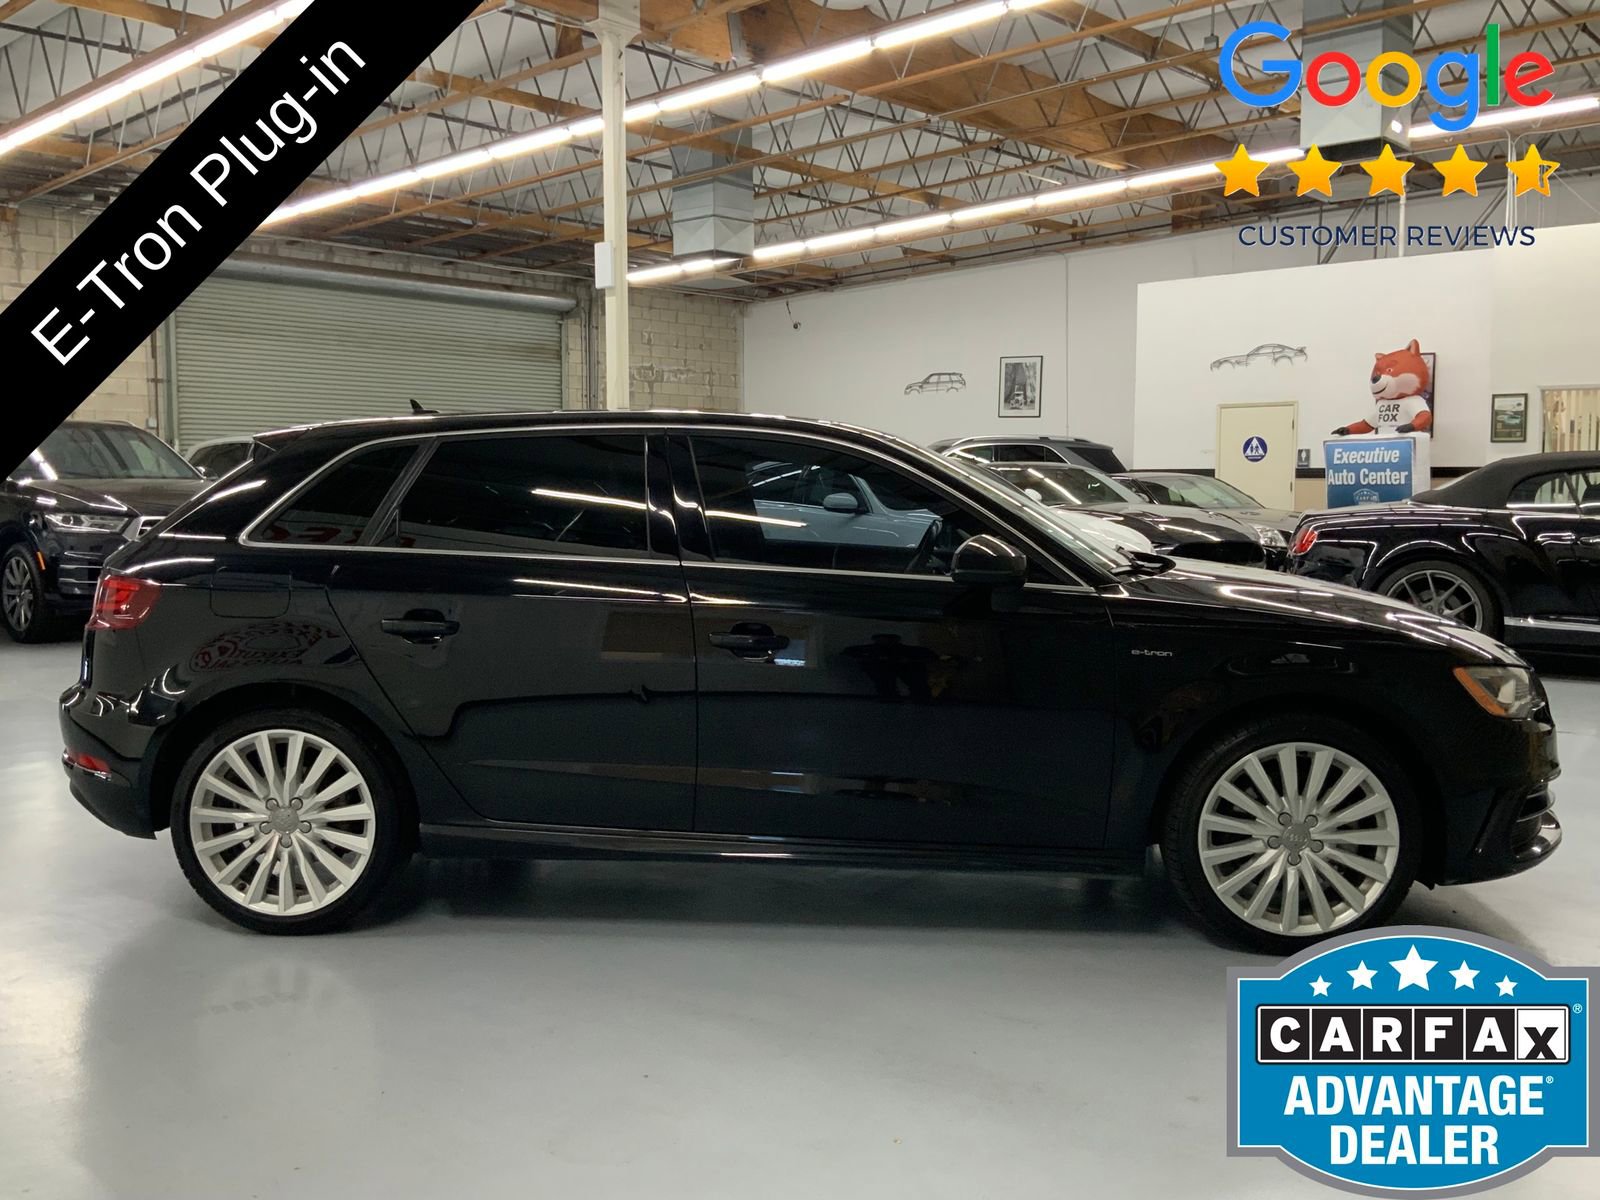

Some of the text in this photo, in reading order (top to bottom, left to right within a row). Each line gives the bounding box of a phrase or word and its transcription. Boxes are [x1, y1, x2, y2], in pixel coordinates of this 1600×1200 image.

[1378, 403, 1400, 413] CAR
[1378, 413, 1398, 422] FOX
[1333, 447, 1400, 464] Executive
[1327, 467, 1409, 485] Auto Center
